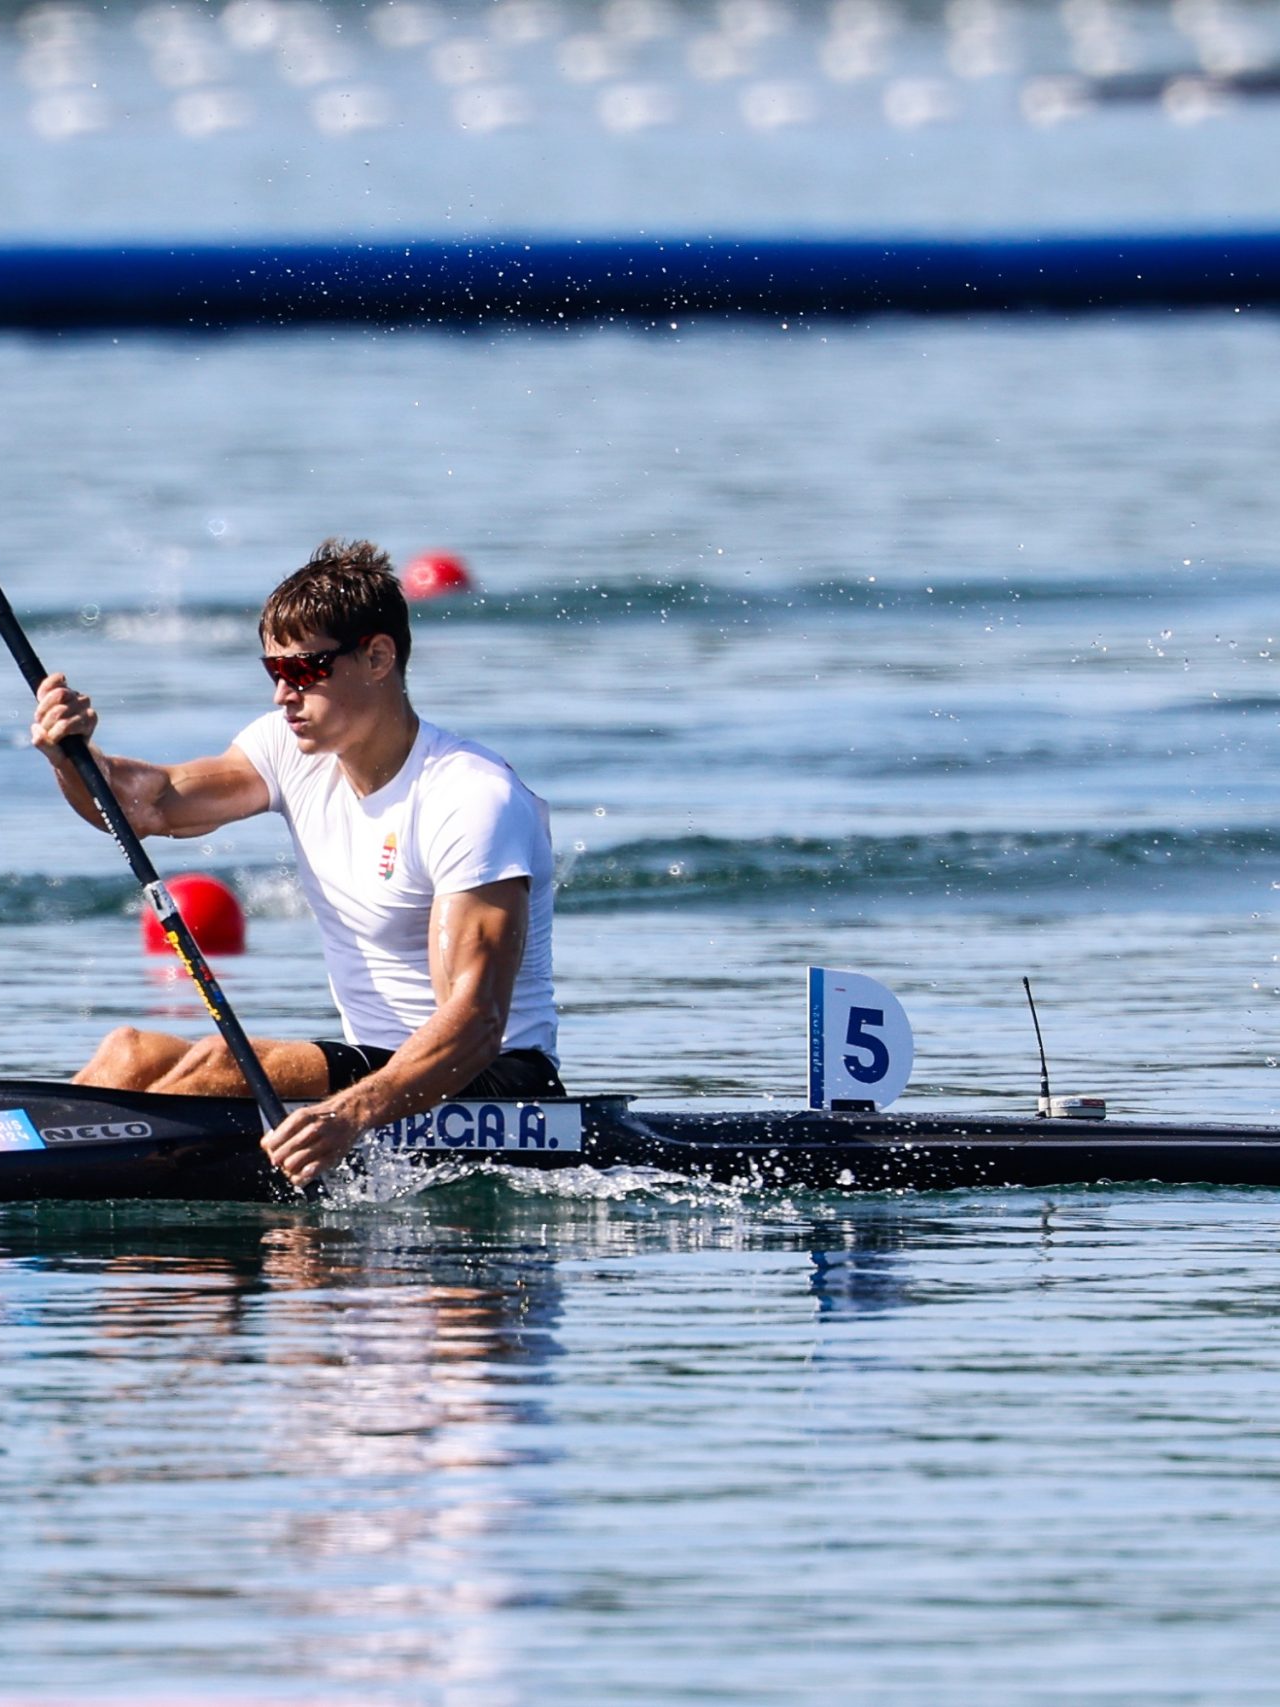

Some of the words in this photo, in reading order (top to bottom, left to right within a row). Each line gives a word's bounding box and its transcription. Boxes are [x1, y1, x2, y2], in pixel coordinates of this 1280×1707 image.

[843, 1006, 889, 1084] 5
[45, 1123, 148, 1142] NELO
[373, 1104, 505, 1148] ARGA
